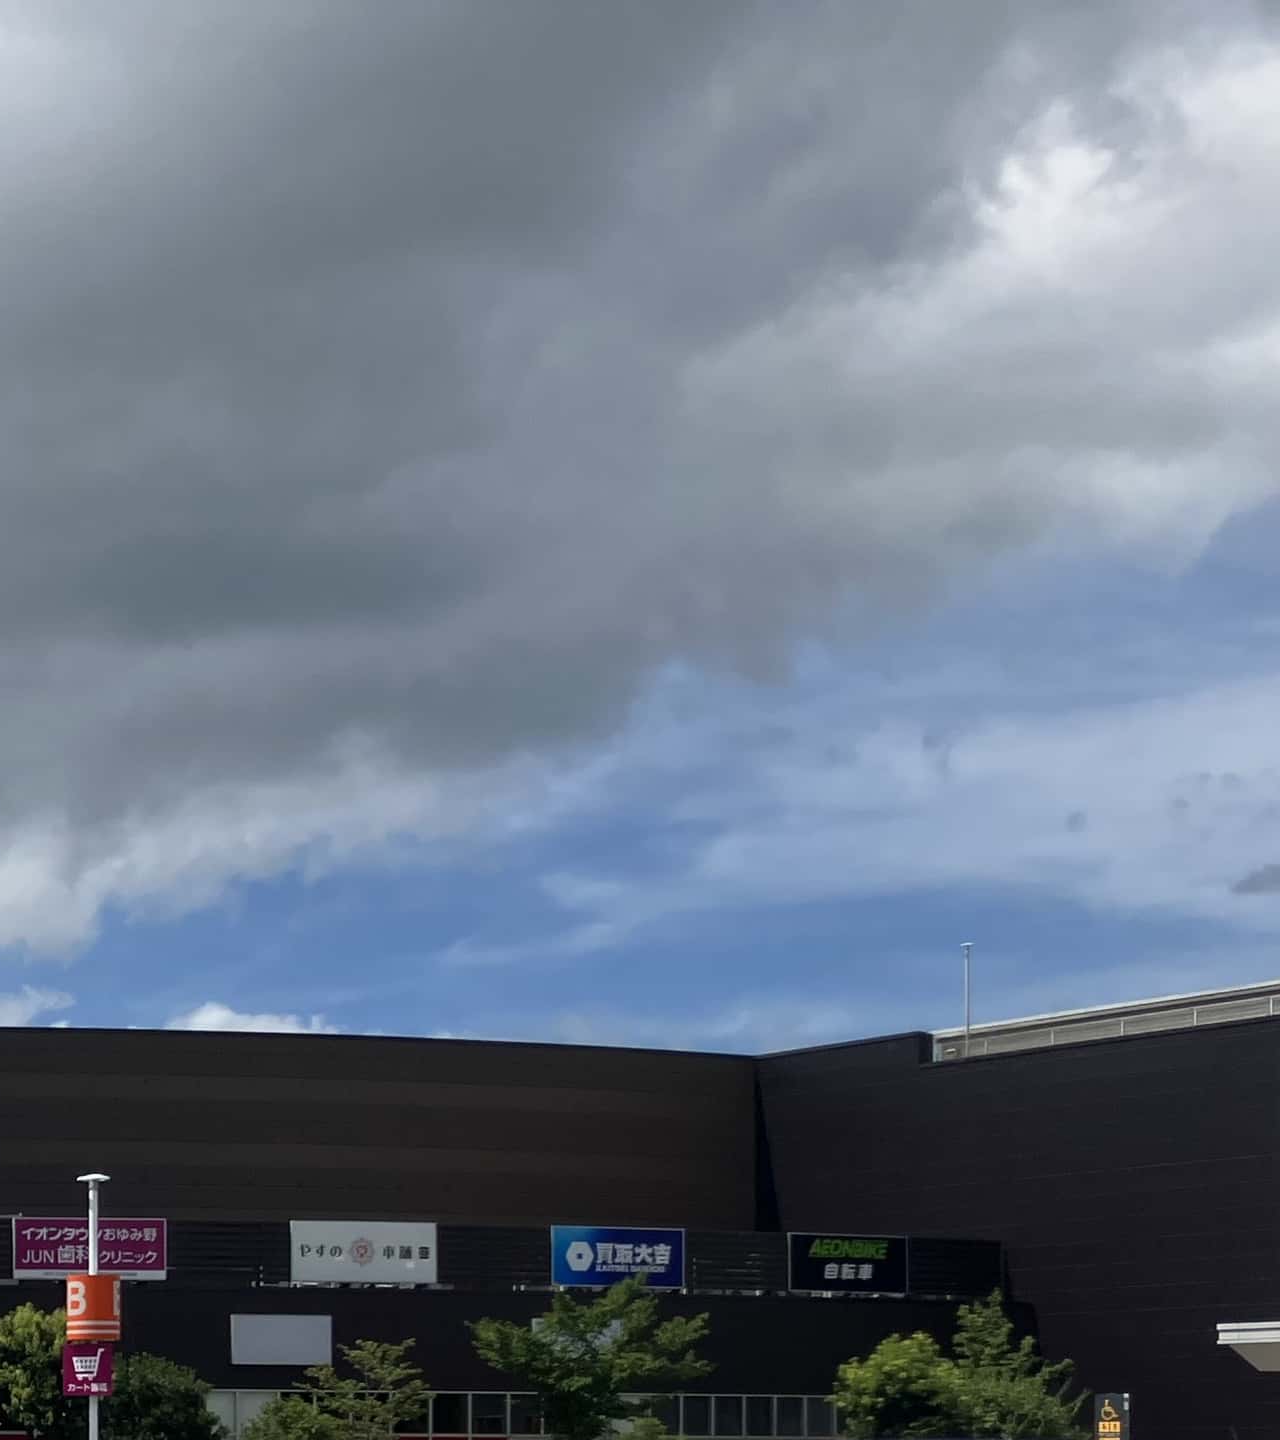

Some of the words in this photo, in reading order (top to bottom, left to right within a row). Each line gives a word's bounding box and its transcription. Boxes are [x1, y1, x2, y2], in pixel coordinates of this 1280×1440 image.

[22, 1227, 158, 1242] イオンタウおゆみ野
[595, 1242, 672, 1265] 買取大吉
[823, 1262, 873, 1280] 自転車
[66, 1280, 87, 1316] B
